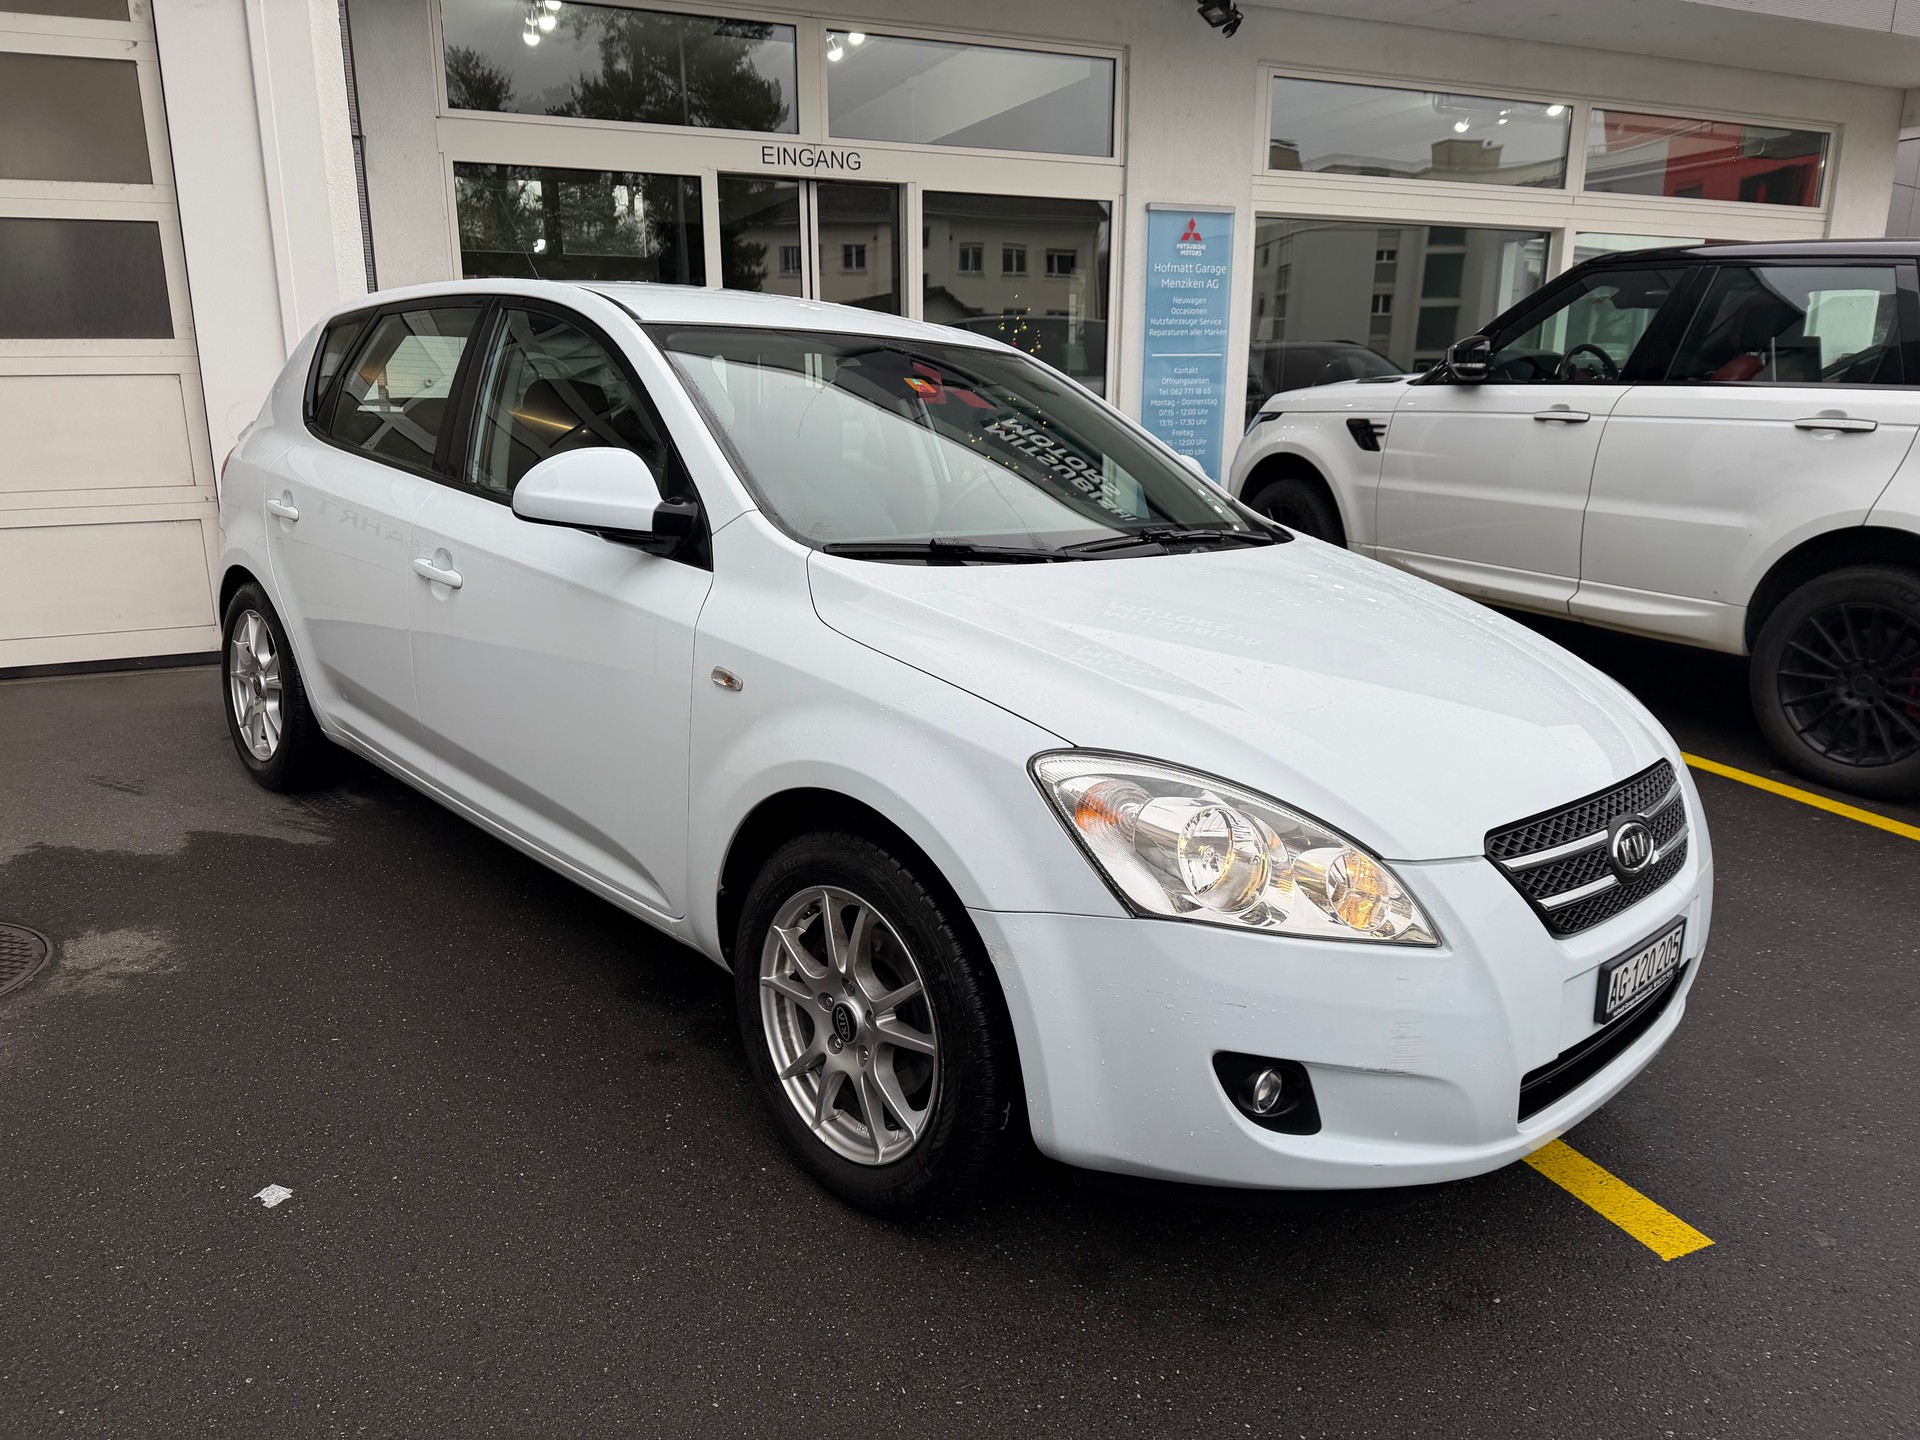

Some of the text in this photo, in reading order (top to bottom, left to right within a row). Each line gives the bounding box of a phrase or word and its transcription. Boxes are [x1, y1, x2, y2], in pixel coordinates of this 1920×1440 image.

[761, 145, 862, 171] EINGANG
[1176, 243, 1206, 251] MITSUBISHI
[1154, 262, 1227, 275] Hofmatt Garage
[1161, 278, 1219, 289] Menziken AG
[1172, 296, 1207, 305] Neuwagen
[1171, 307, 1208, 315] Occasionen
[1150, 317, 1198, 326] Nutzfahrzeuge
[1149, 328, 1228, 337] Reparaturen aller Marken
[1150, 399, 1175, 407] Montag
[1181, 398, 1218, 406] Donnerstag
[1172, 429, 1195, 437] Freitag
[838, 1012, 849, 1035] KIA
